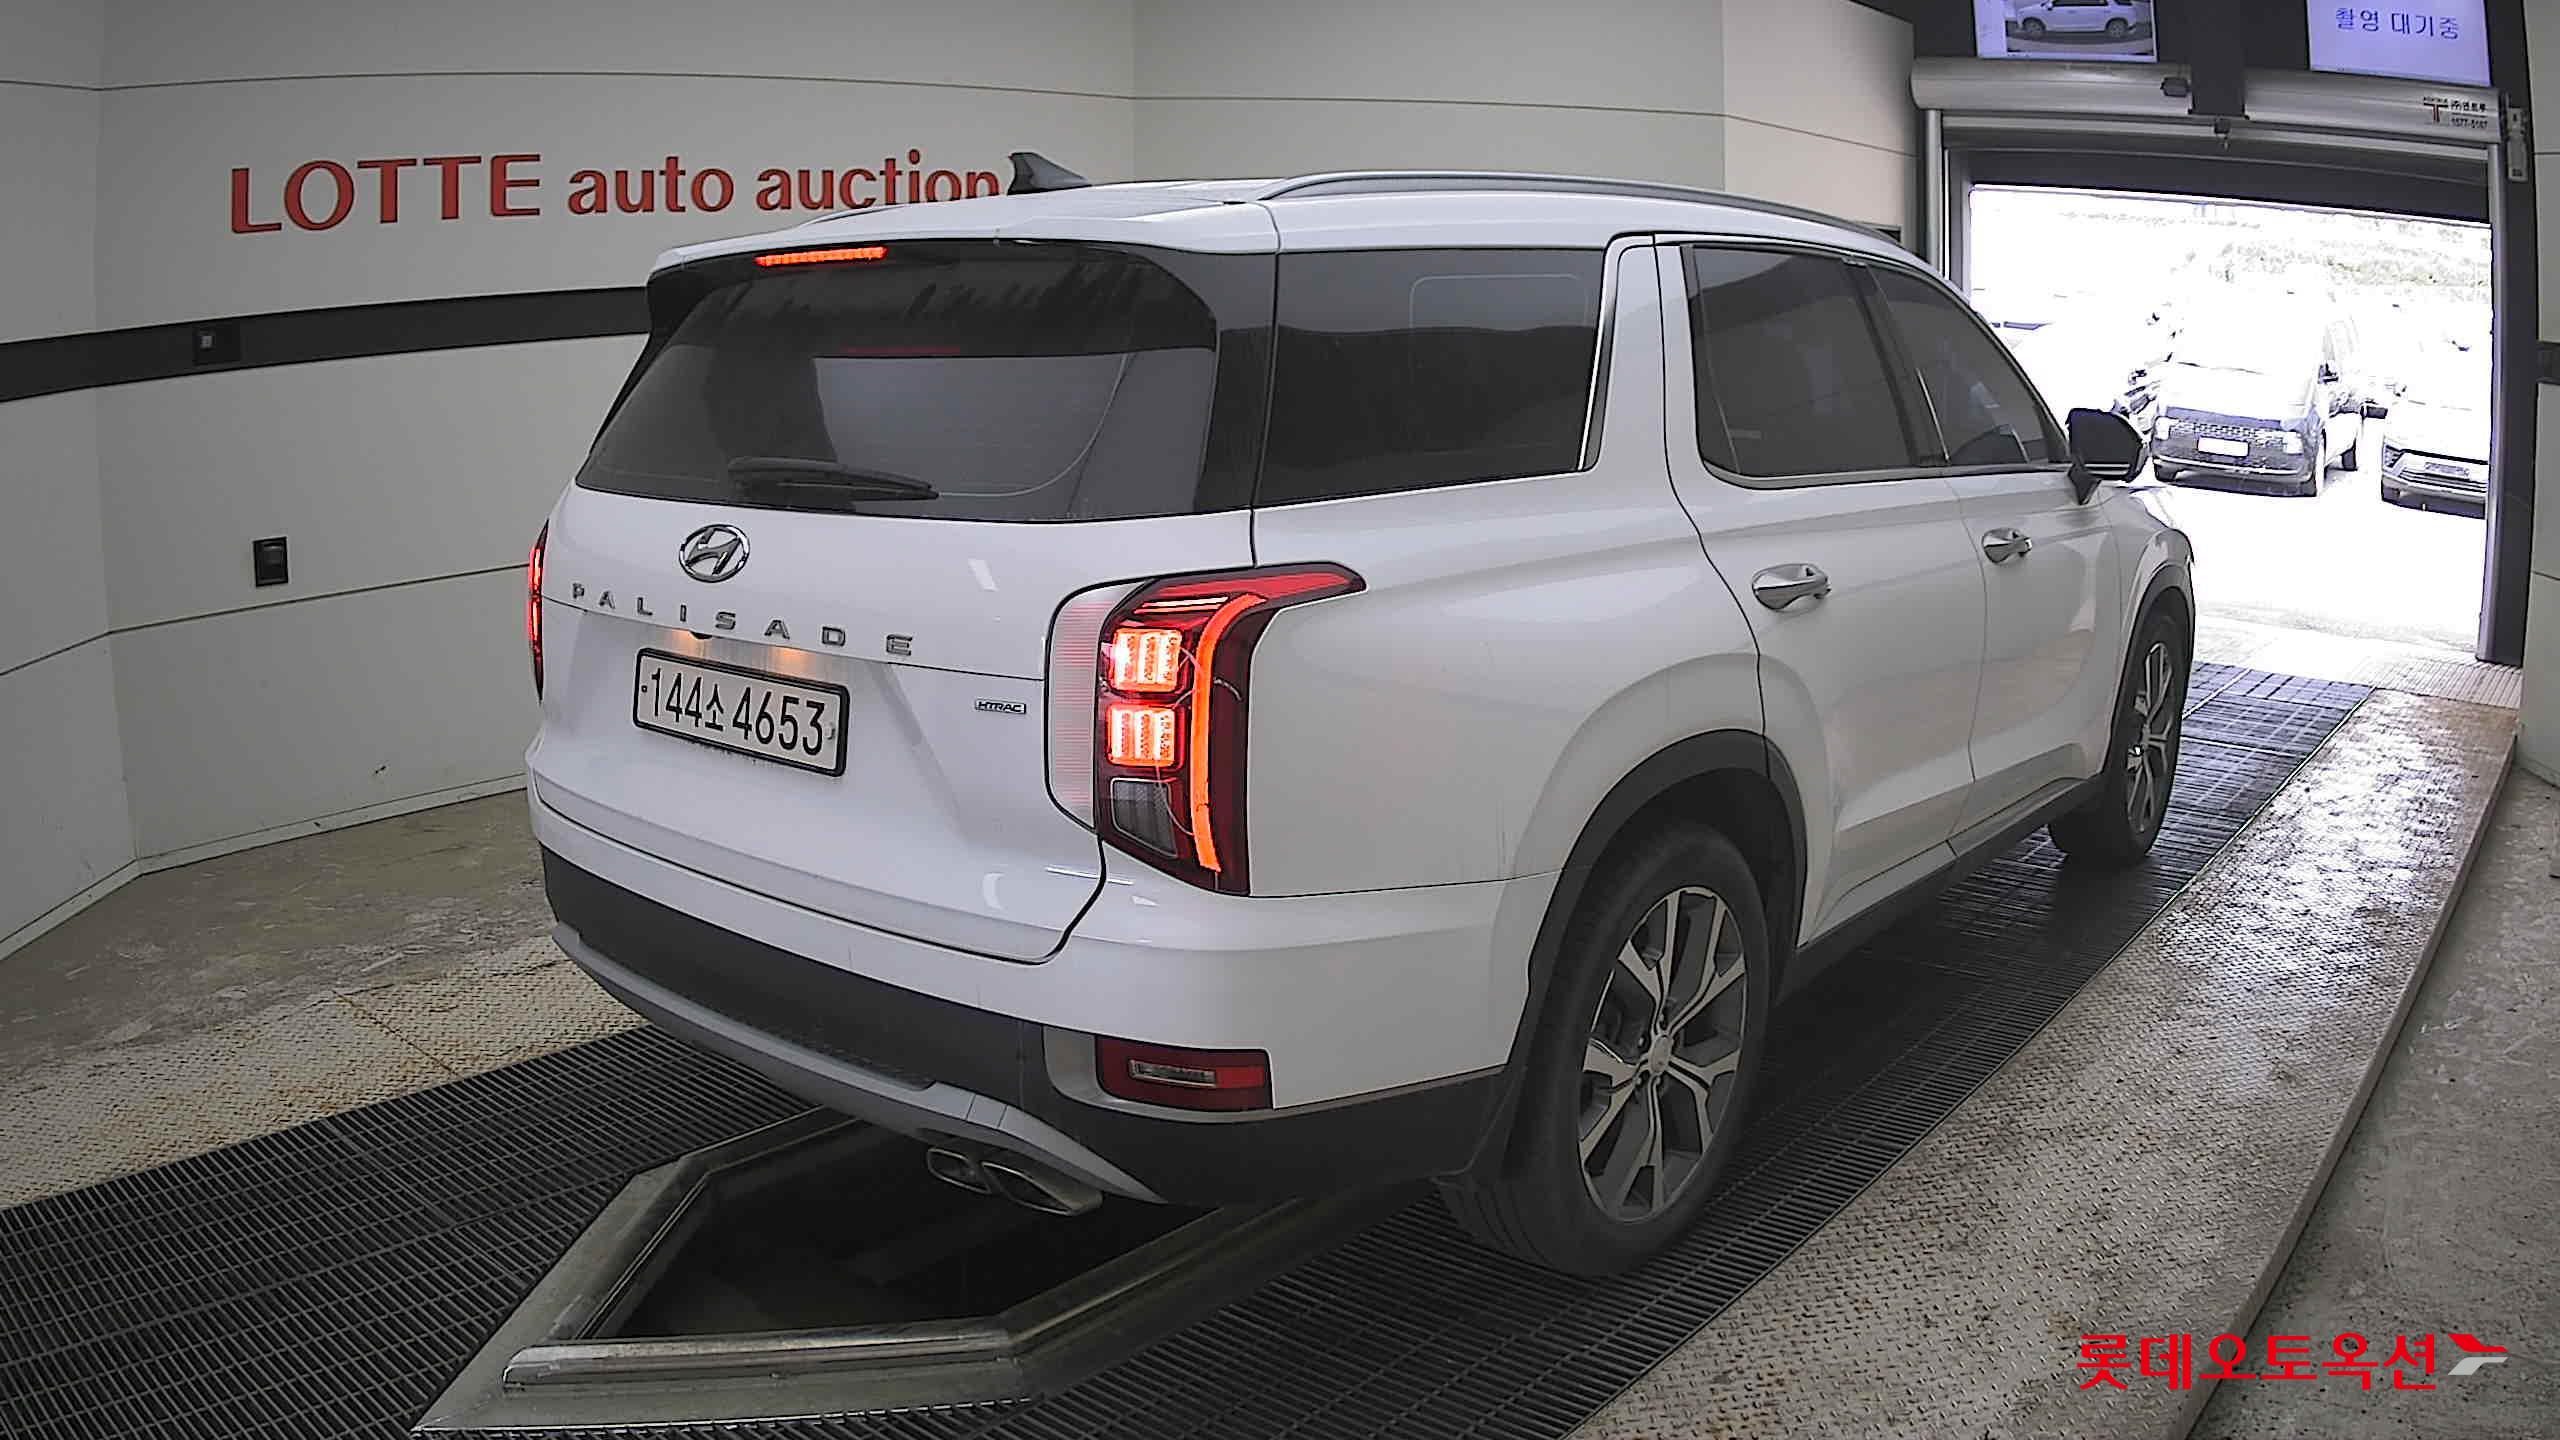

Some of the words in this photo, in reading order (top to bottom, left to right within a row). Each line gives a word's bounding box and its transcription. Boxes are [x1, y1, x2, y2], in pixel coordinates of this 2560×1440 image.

[2335, 8, 2379, 32] 촬영
[2391, 12, 2459, 40] 대기중
[231, 153, 542, 234] LOTTE
[567, 156, 735, 214] auto
[756, 149, 1000, 210] auction
[571, 582, 914, 657] PALISADE
[975, 700, 1024, 713] HTRAC
